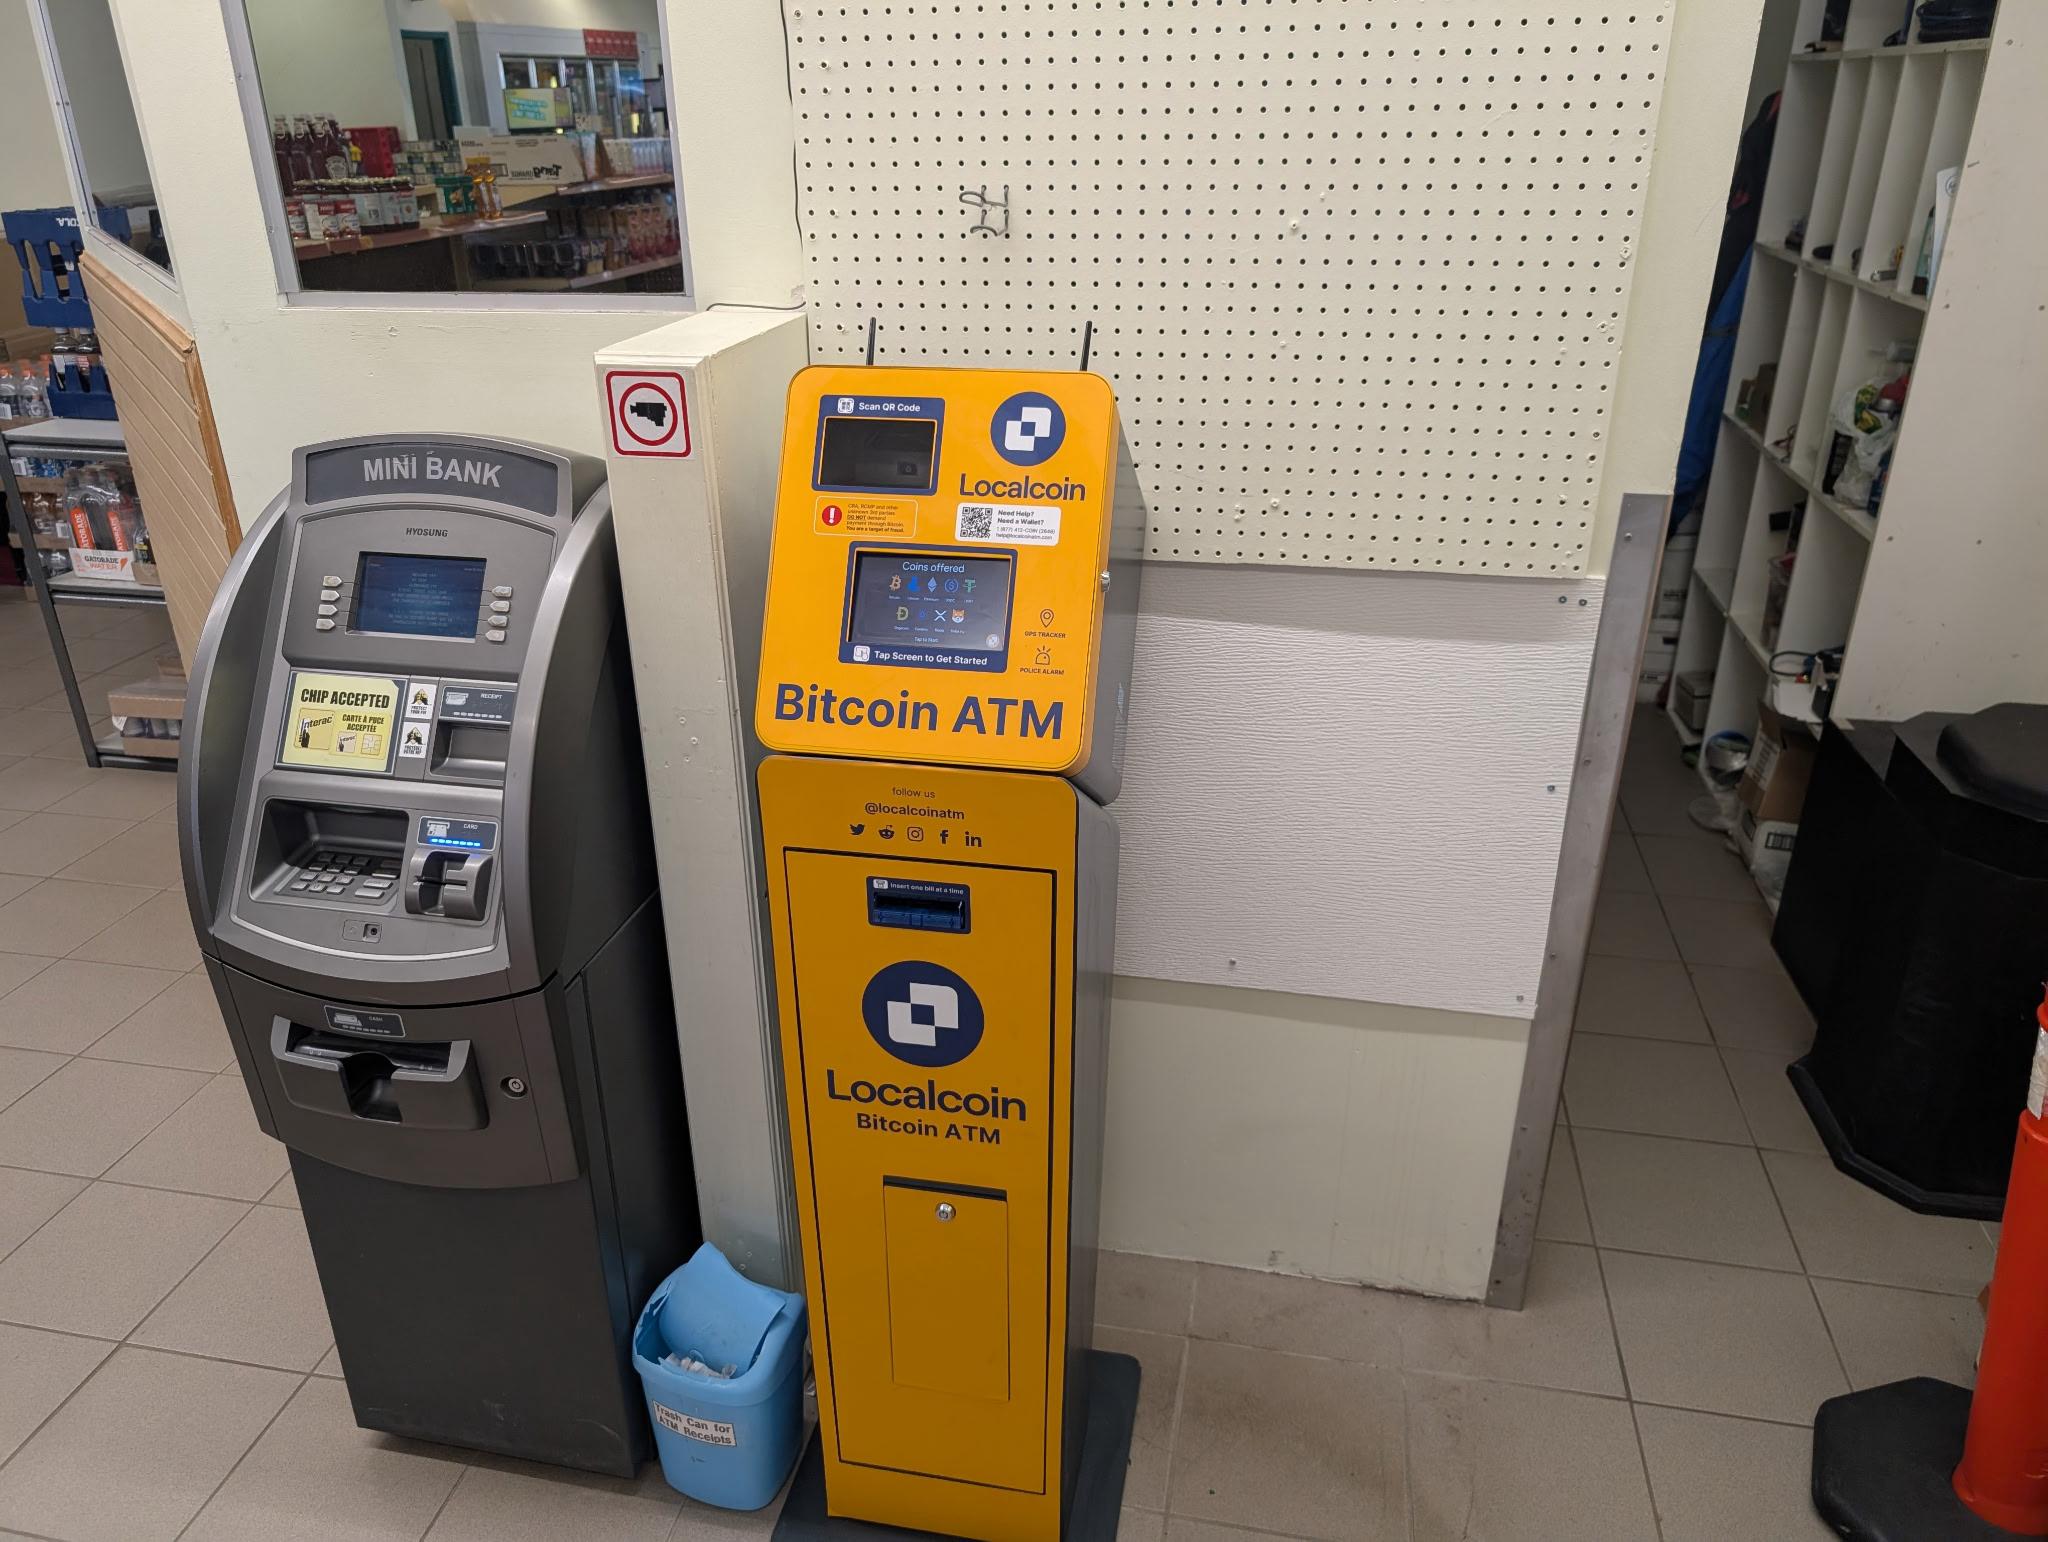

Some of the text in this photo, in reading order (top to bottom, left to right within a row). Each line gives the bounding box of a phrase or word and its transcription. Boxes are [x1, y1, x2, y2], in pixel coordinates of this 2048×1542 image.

[858, 401, 921, 413] Scan QR Code
[363, 457, 503, 488] MINI BANK
[959, 473, 1086, 502] Localcoin
[74, 513, 91, 549] ATORADE
[405, 527, 449, 538] HYOSUNG
[84, 556, 119, 565] GATORADE
[903, 561, 965, 573] Coins offered
[874, 651, 988, 665] Tap Screen to Get Started
[301, 688, 390, 709] CHIP ACCEPTED
[342, 714, 361, 723] CARTE
[369, 716, 385, 725] PUCE
[775, 683, 1064, 741] Bitcoin ATM
[347, 723, 377, 733] ACCEPTÉE
[892, 788, 936, 799] follow us
[865, 803, 965, 820] @localcoinatm
[965, 831, 983, 848] in
[890, 882, 910, 890] Insert
[924, 884, 935, 892] bill
[949, 887, 964, 895] time
[826, 1069, 1027, 1122] Localcoin
[857, 1113, 1001, 1145] Bitcoin ATM
[655, 1404, 731, 1433] Trash Can for
[659, 1415, 733, 1445] ATM Receipts
